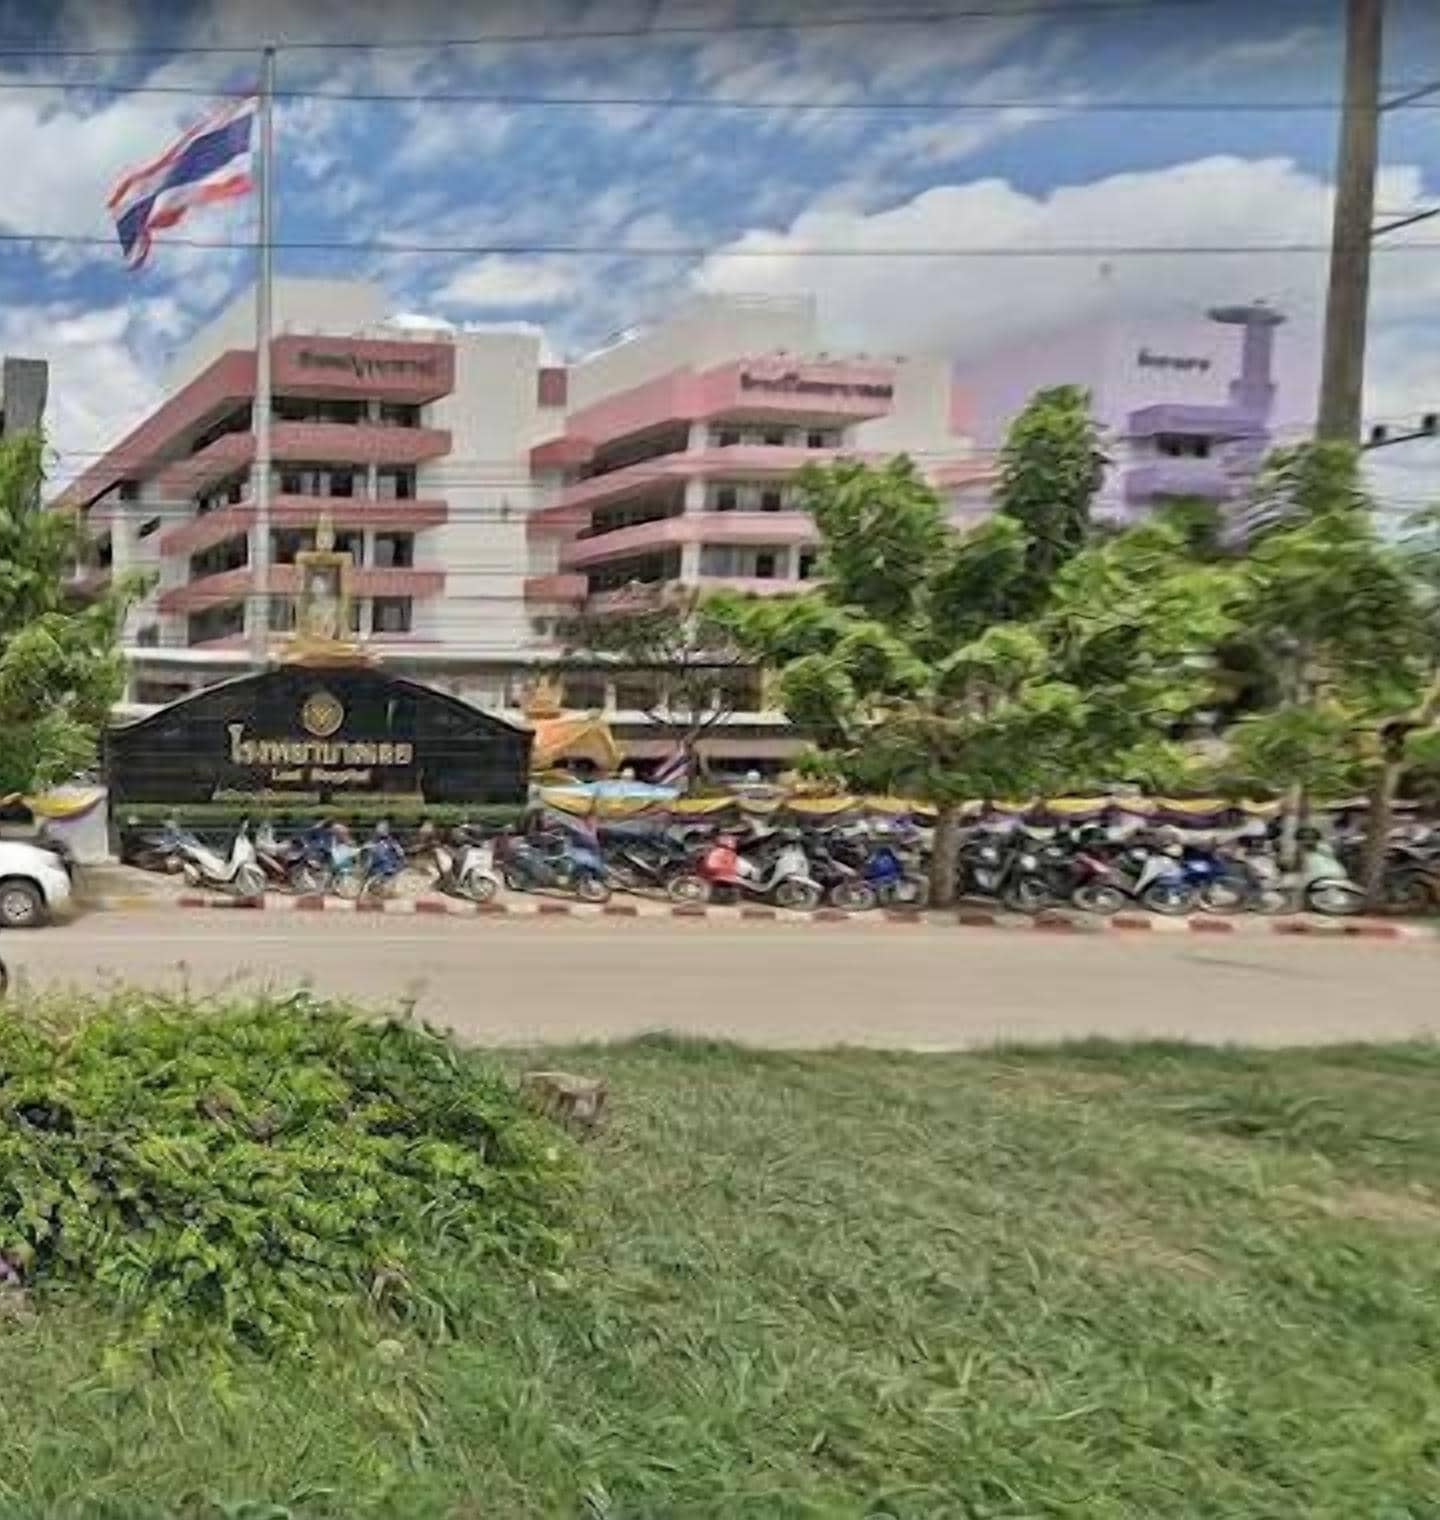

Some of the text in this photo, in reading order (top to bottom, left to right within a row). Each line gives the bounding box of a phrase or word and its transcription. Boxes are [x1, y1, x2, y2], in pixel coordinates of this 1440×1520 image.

[227, 723, 413, 765] โรงพยาบาลเลย
